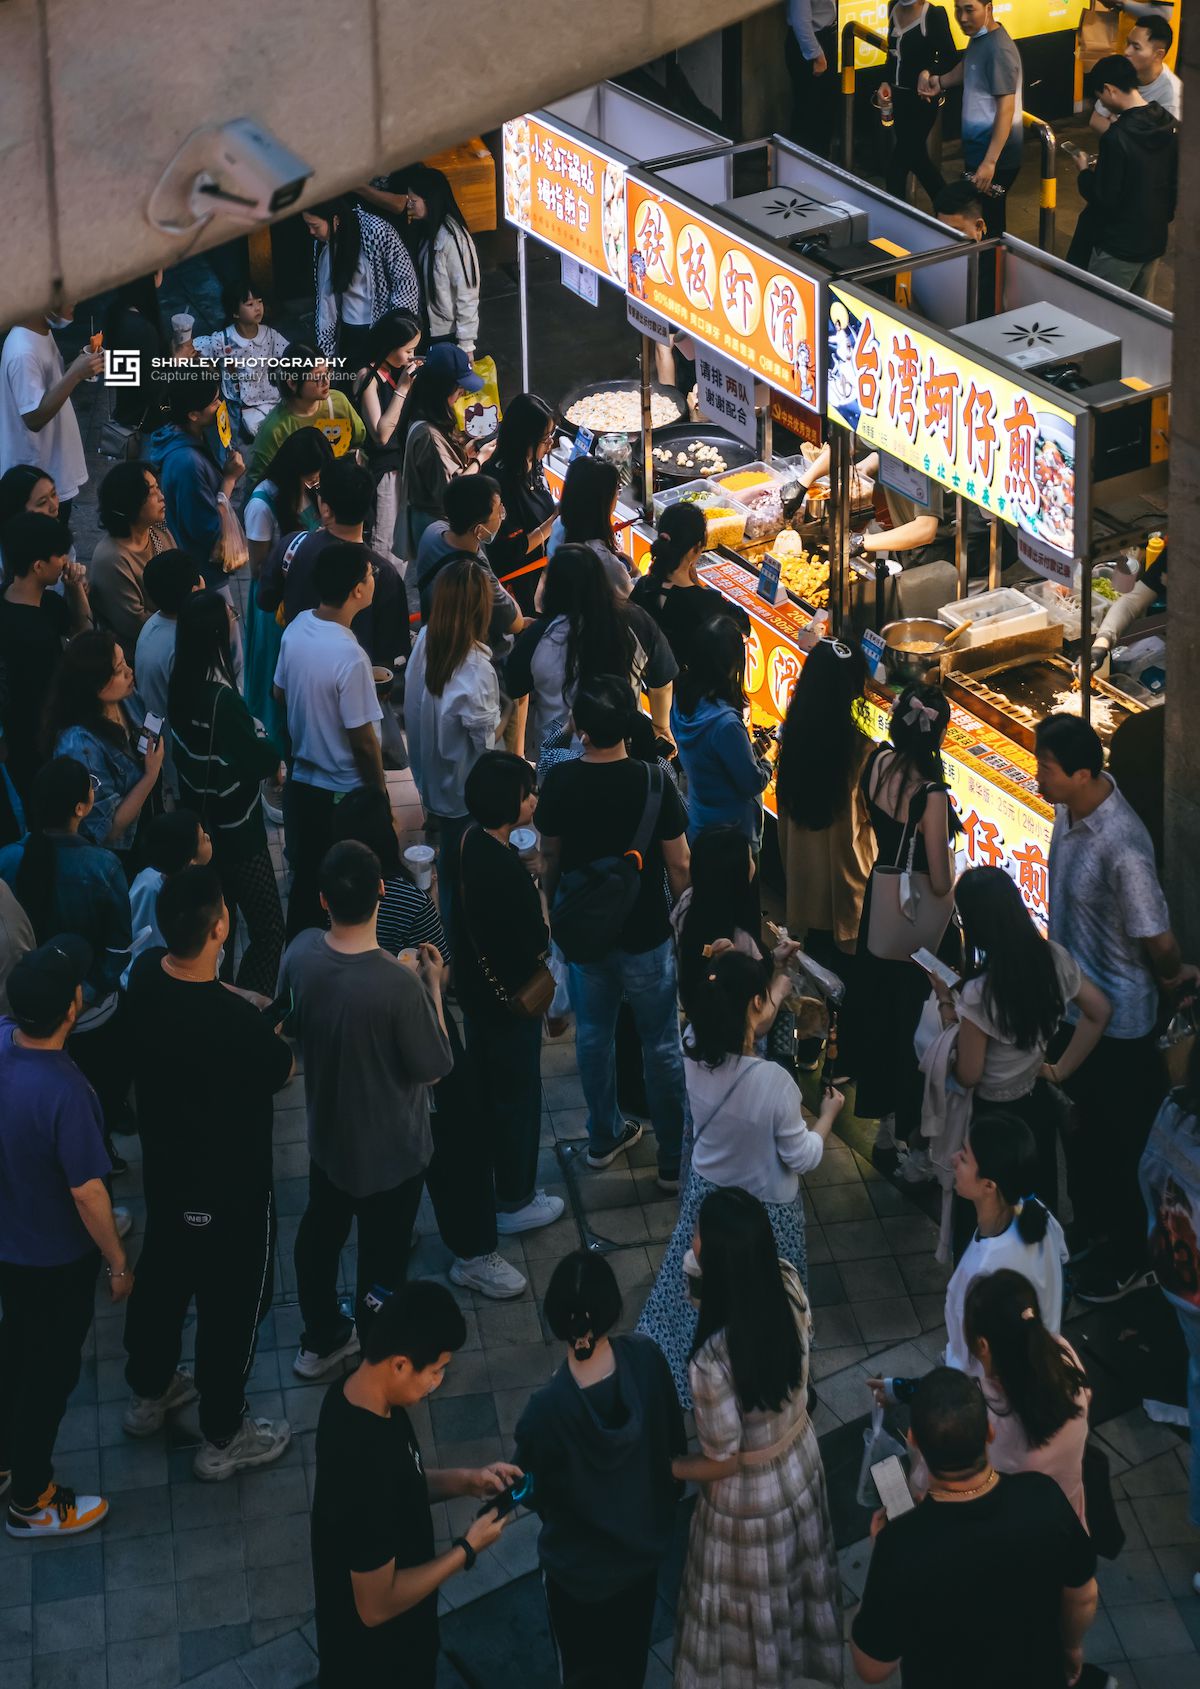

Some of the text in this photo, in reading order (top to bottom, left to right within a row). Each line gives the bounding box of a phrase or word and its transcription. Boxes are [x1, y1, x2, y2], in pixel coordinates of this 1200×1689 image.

[530, 133, 595, 195] 小龙虾锅贴
[537, 177, 590, 233] 拇指煎包
[638, 204, 797, 363] 铁板虾滑
[700, 359, 750, 406] 请排 两队
[705, 387, 748, 426] 谢谢配合
[854, 317, 1037, 504] 台湾蚵仔煎
[950, 794, 1048, 913] 仔煎
